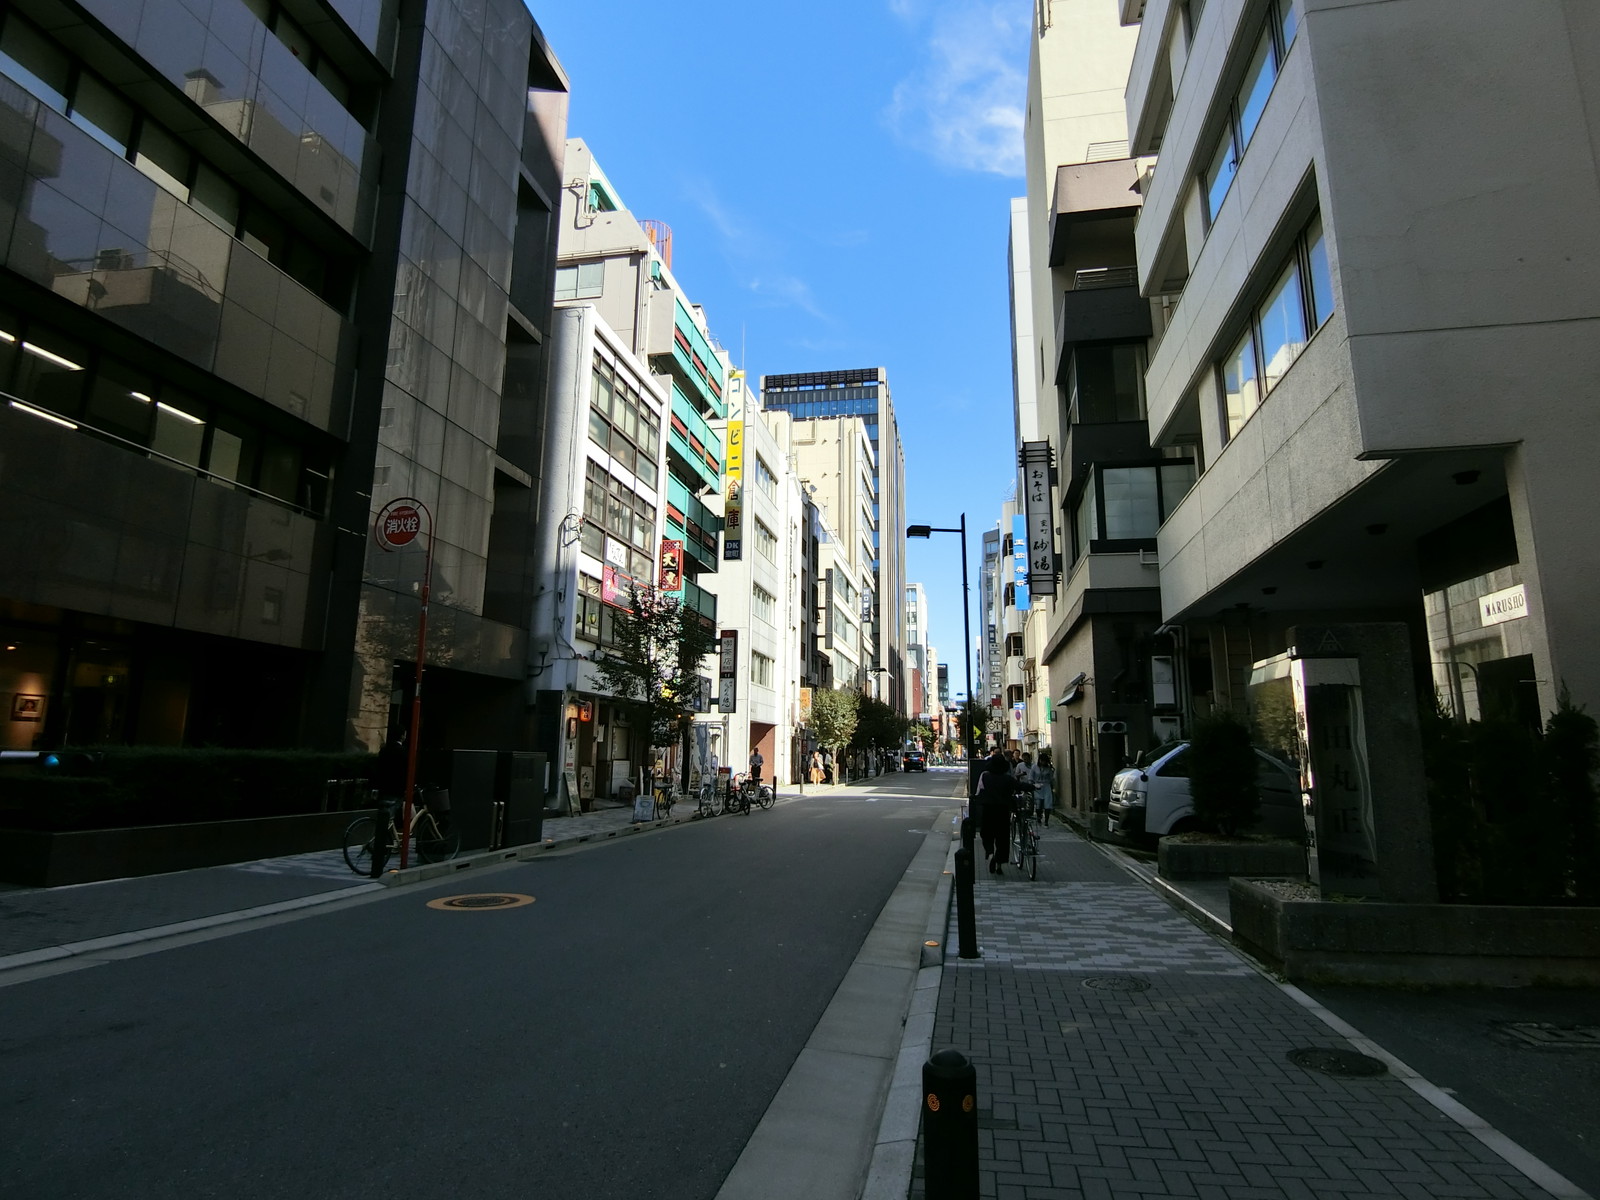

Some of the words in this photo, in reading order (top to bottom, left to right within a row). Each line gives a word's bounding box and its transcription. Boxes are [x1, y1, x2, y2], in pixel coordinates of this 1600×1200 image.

[727, 377, 741, 530] コンビニ倉庫
[1032, 469, 1045, 502] おそば
[386, 516, 418, 534] 消火栓
[1033, 538, 1050, 571] 砂場
[1485, 593, 1524, 616] MARUSHO
